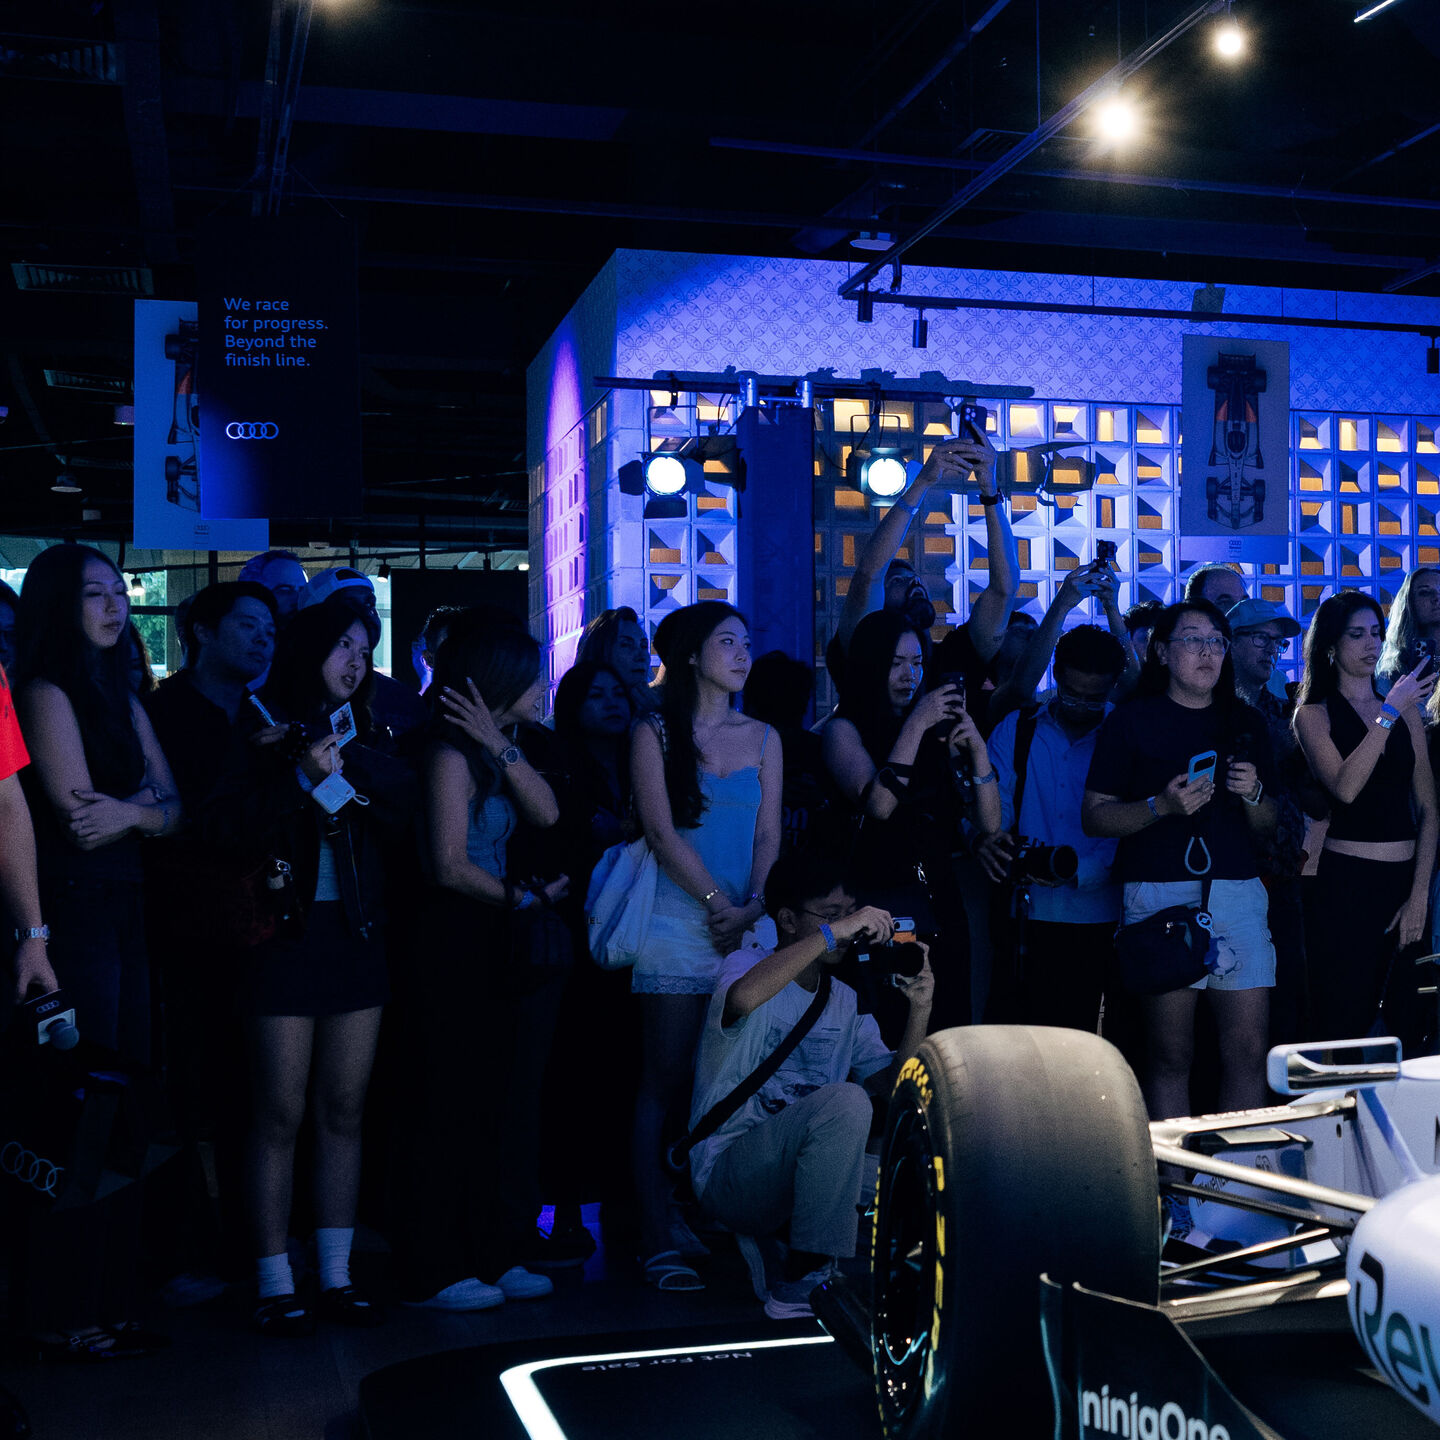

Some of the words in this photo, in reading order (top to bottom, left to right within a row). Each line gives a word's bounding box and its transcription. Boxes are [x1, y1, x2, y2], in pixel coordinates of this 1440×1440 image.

[224, 297, 251, 311] We
[256, 300, 289, 311] race
[224, 315, 249, 329] for
[253, 319, 329, 333] progress.
[225, 334, 285, 351] Beyond
[290, 334, 317, 348] the
[225, 352, 271, 367] finish
[276, 352, 311, 367] line.
